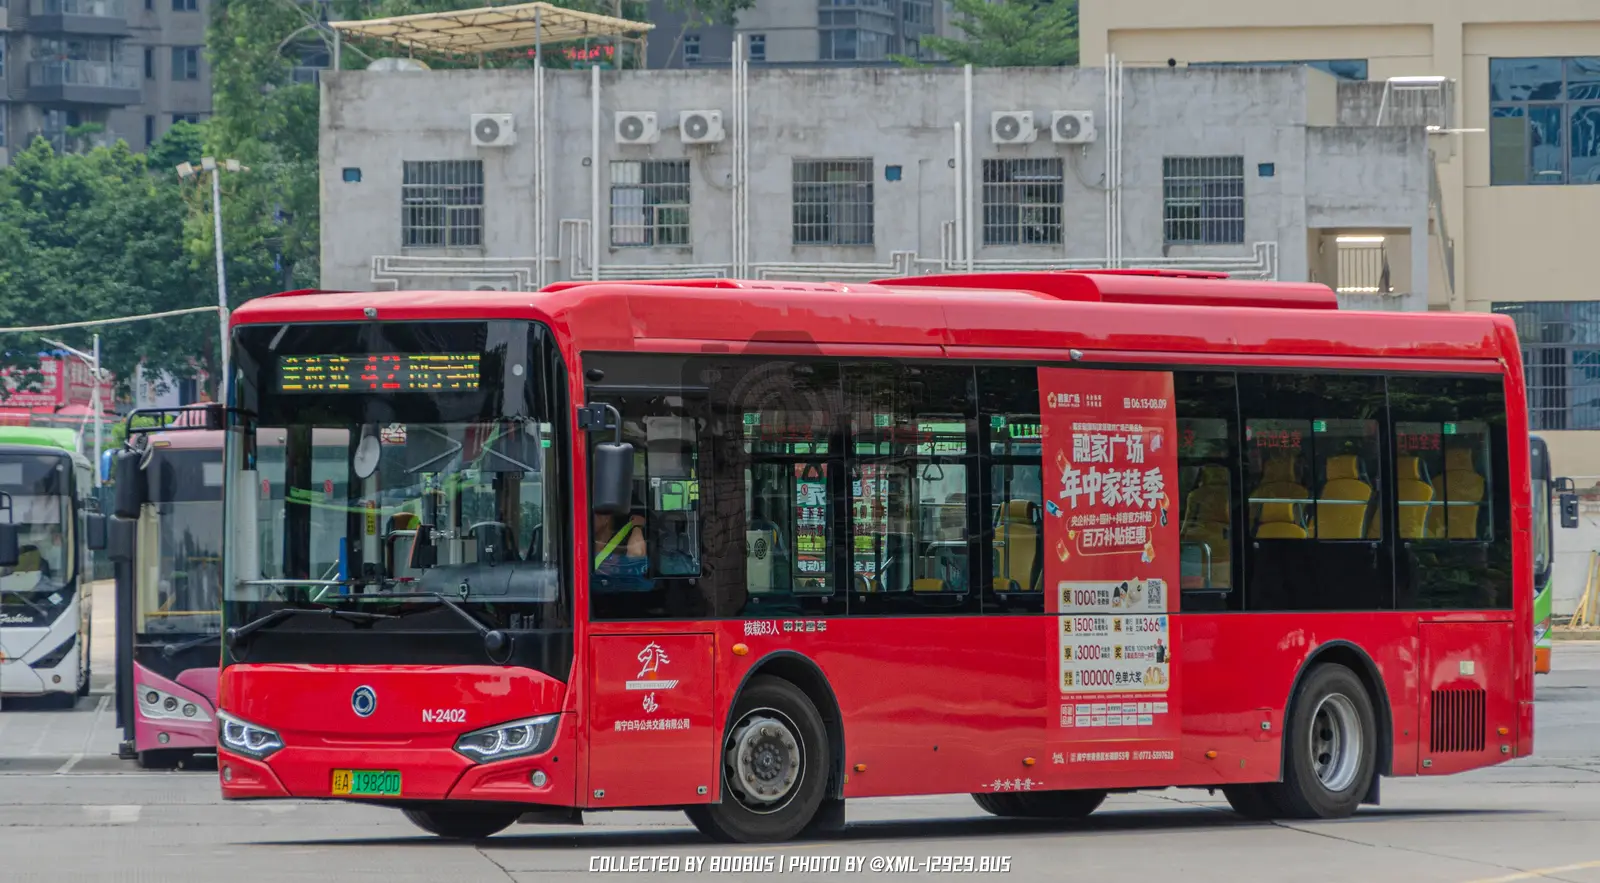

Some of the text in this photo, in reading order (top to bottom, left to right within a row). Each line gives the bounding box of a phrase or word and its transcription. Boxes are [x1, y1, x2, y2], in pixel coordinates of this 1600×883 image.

[360, 355, 401, 390] 42
[1072, 433, 1144, 464] 融家广场
[1060, 466, 1165, 510] 年中家装季
[1074, 590, 1097, 605] 1000
[744, 620, 780, 636] 核载83人
[783, 620, 827, 632] 申龙客车
[1074, 618, 1094, 632] 1500
[1143, 617, 1160, 632] 366
[1077, 645, 1101, 660] 3000
[1081, 669, 1115, 686] 100000
[1115, 671, 1142, 684] 免单大奖
[422, 708, 467, 723] N-2402
[614, 718, 690, 732] 南宁白马公共交通有限公司
